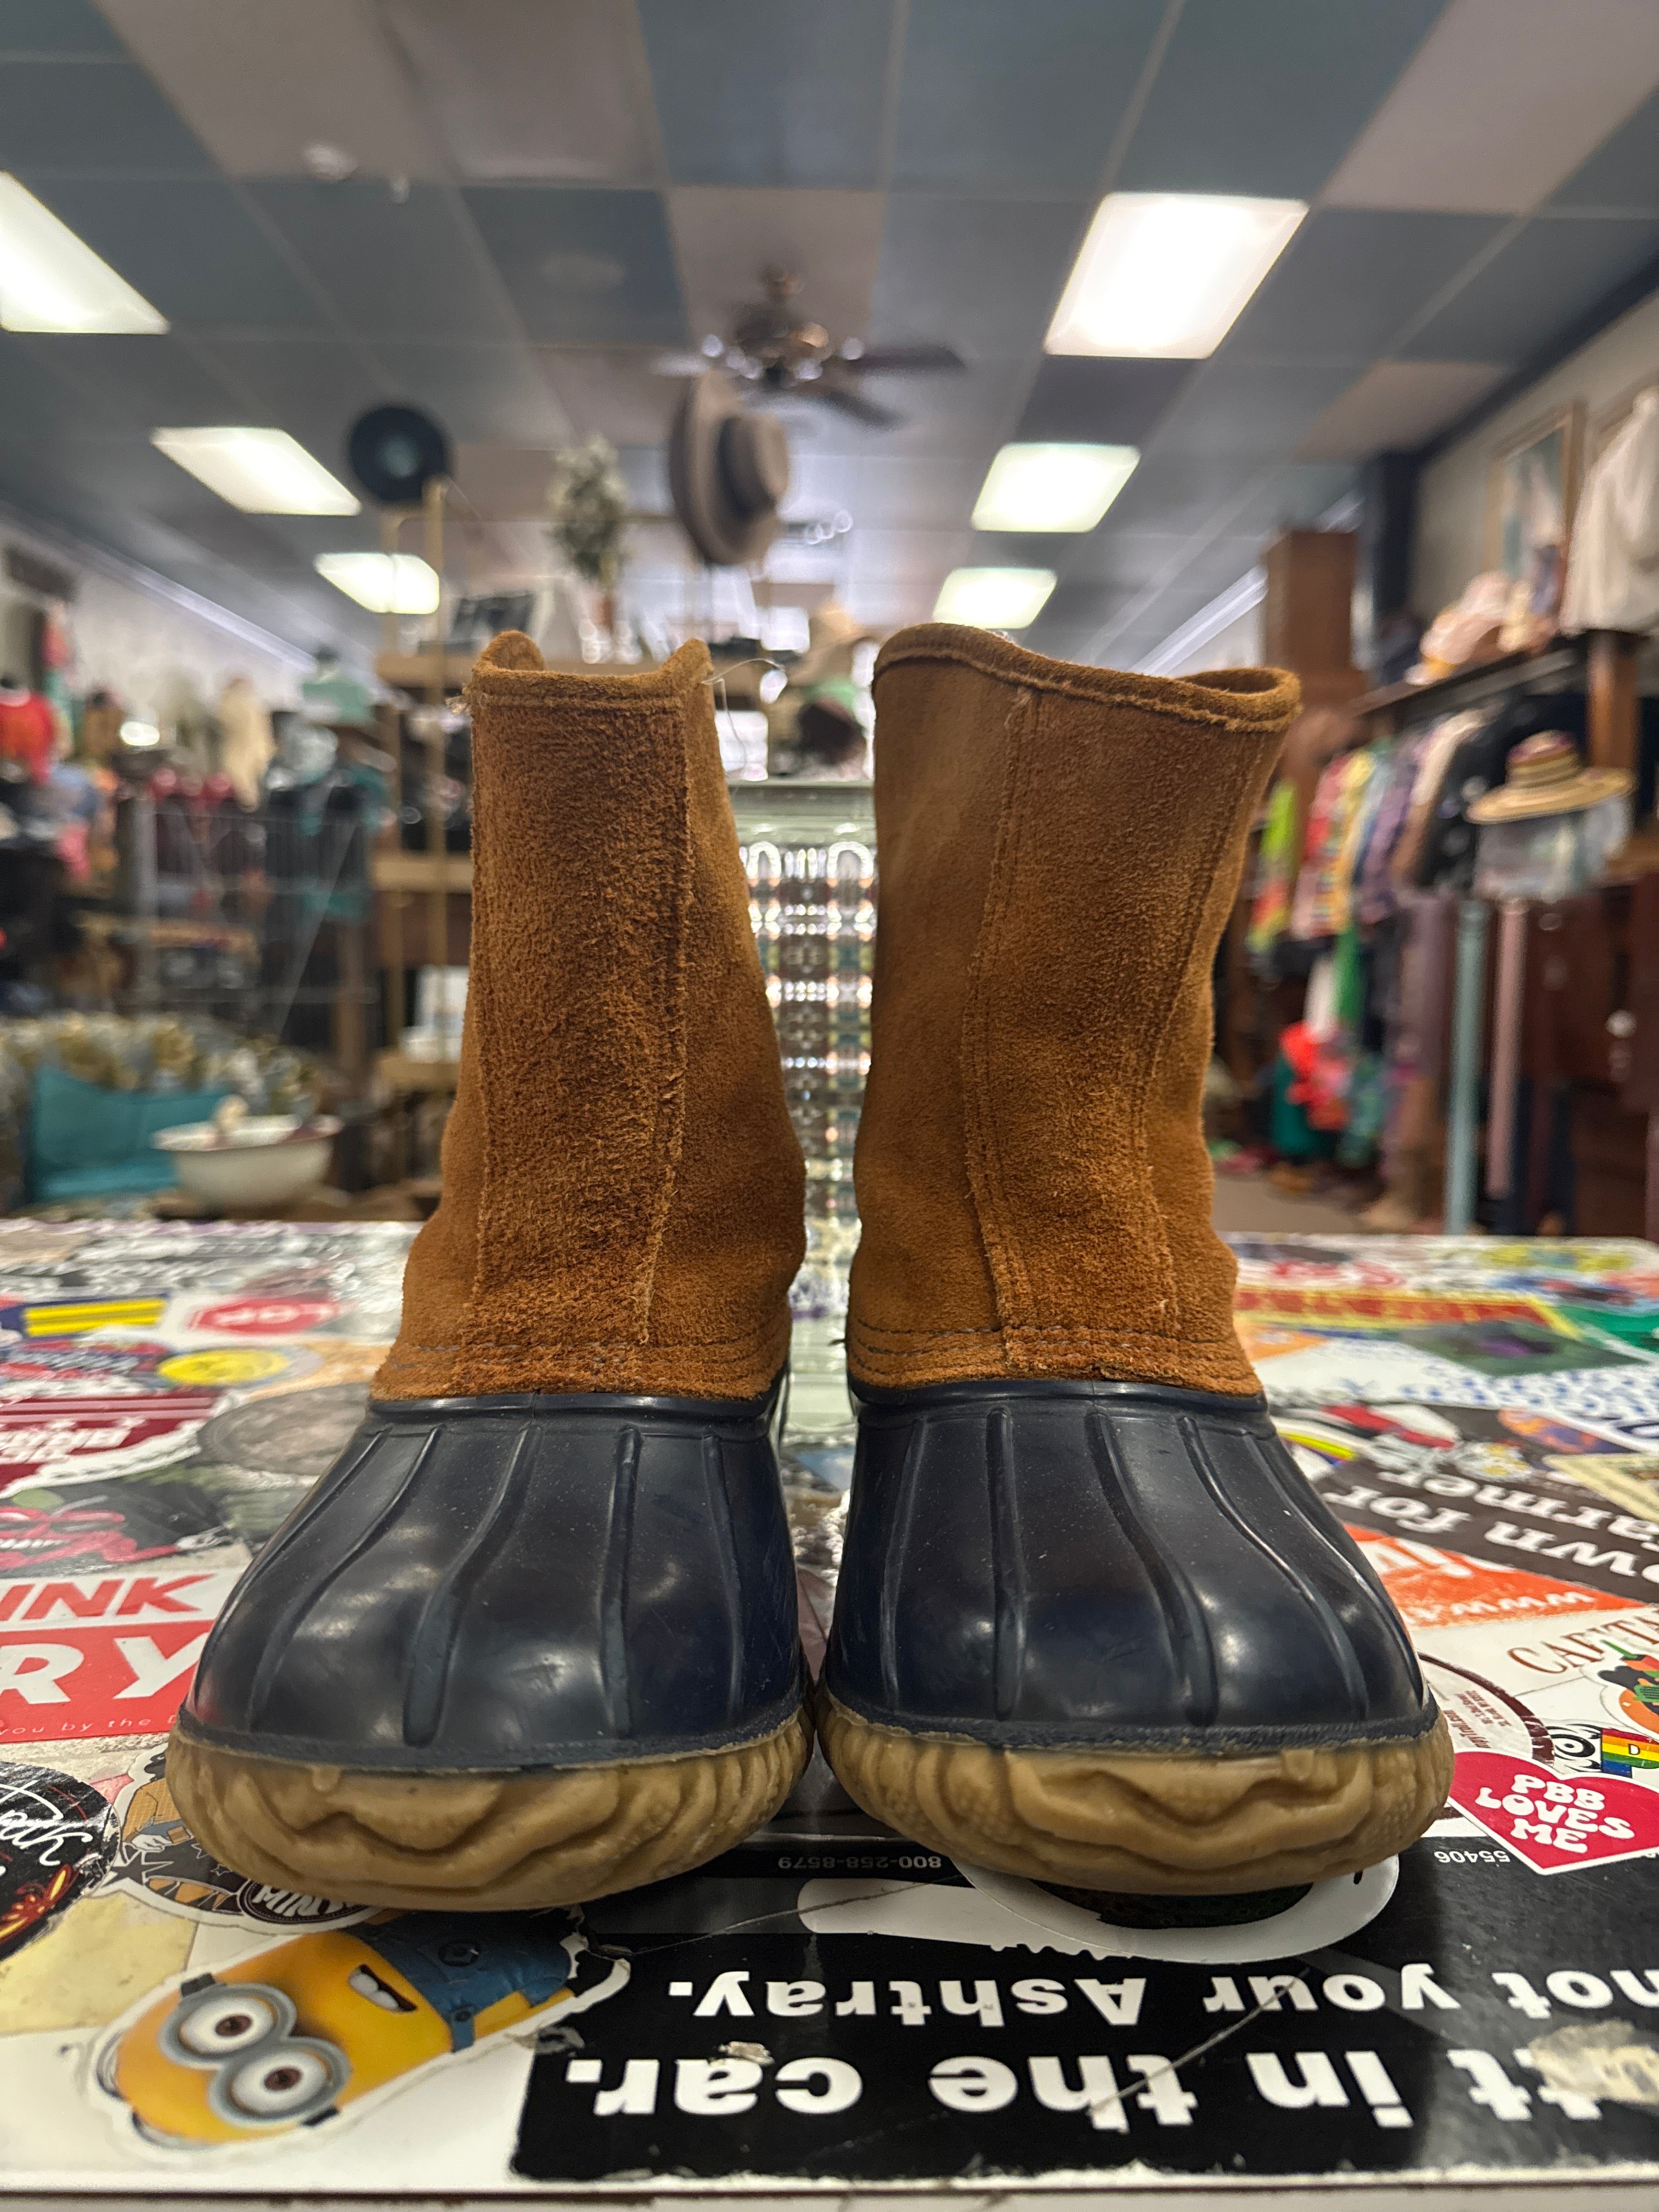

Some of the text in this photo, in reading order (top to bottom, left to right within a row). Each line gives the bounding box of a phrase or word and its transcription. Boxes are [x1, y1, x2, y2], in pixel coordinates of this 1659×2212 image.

[1322, 1485, 1474, 1534] for
[1378, 1471, 1659, 1553] armer
[61, 1722, 93, 1732] by
[108, 1718, 151, 1728] the
[1475, 1787, 1635, 1839] LOVES
[1511, 1774, 1605, 1811] PBB
[778, 1850, 1511, 1869] 55406 800-258-8579
[1510, 1818, 1588, 1854] ME
[668, 1963, 1659, 2027] not your Ashtray.
[566, 2057, 863, 2115] car.
[929, 2055, 1198, 2133] the
[1246, 2051, 1414, 2128] in
